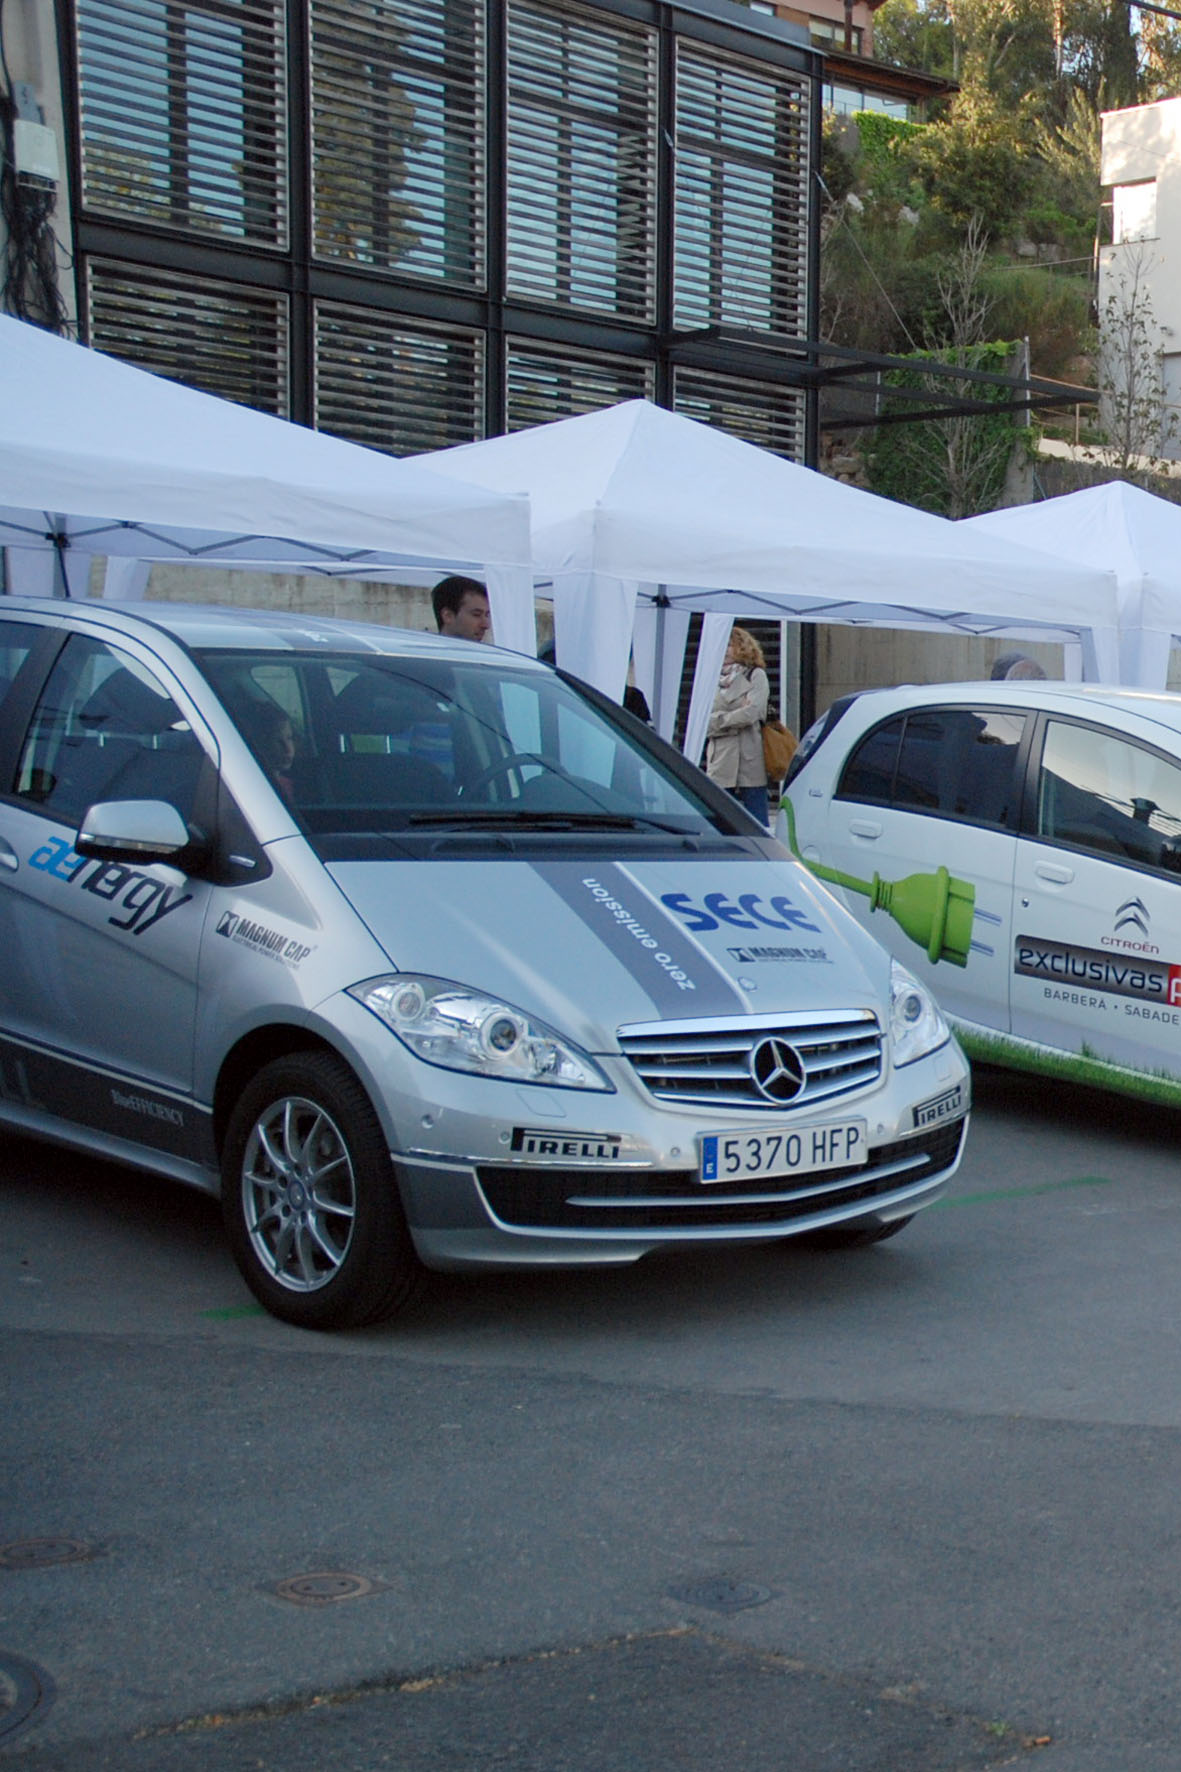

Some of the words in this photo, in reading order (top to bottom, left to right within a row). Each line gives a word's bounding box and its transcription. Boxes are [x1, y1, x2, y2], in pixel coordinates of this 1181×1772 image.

[582, 878, 659, 949] emission
[236, 918, 288, 954] MAGNUM
[283, 940, 311, 962] CAP
[1101, 936, 1160, 955] CITROËN
[653, 952, 697, 991] zero
[1019, 948, 1164, 993] exclusivas
[913, 1085, 961, 1128] PIRELLI
[511, 1127, 621, 1159] PIRELLI
[724, 1134, 802, 1173] 5370
[812, 1126, 860, 1164] HFP
